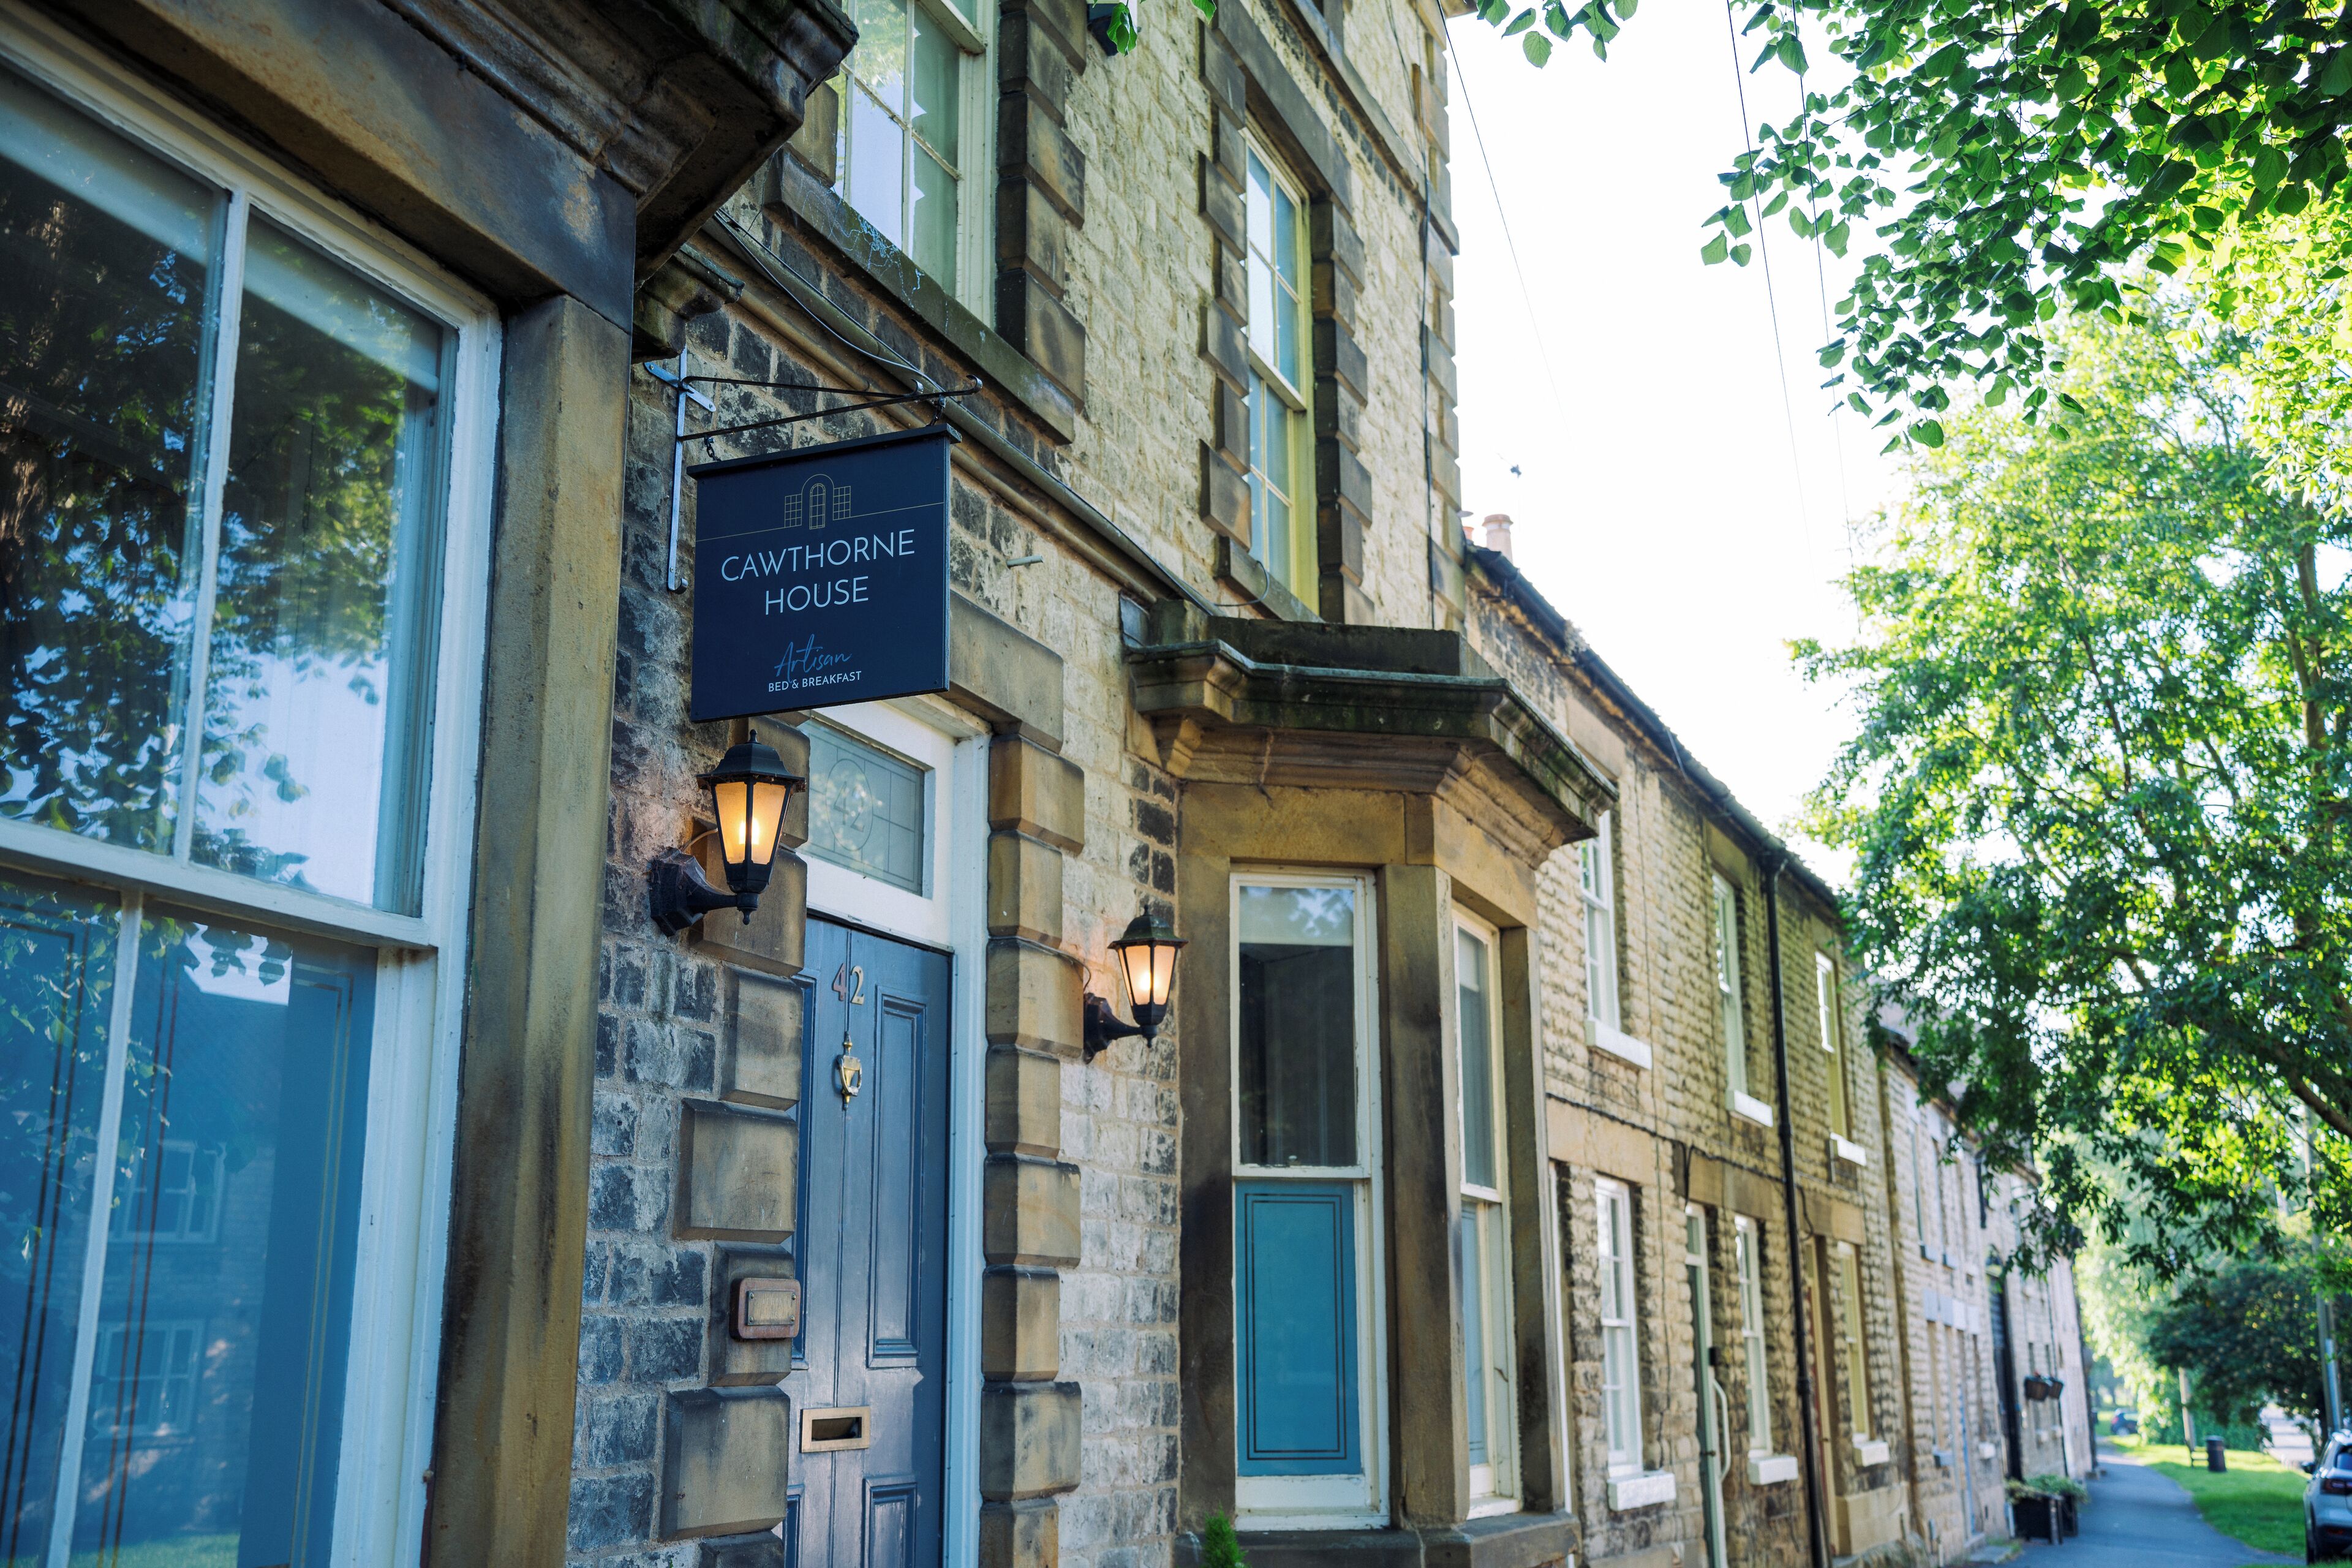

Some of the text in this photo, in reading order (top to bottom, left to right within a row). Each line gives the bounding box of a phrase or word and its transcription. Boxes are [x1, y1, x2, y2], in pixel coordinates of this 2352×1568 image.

[722, 529, 914, 581] CAWTHORNE
[766, 576, 869, 615] HOUSE
[768, 671, 862, 692] BED & BREAKFAST
[774, 634, 853, 683] Artisan
[833, 781, 865, 832] 42
[832, 962, 864, 1005] 42
